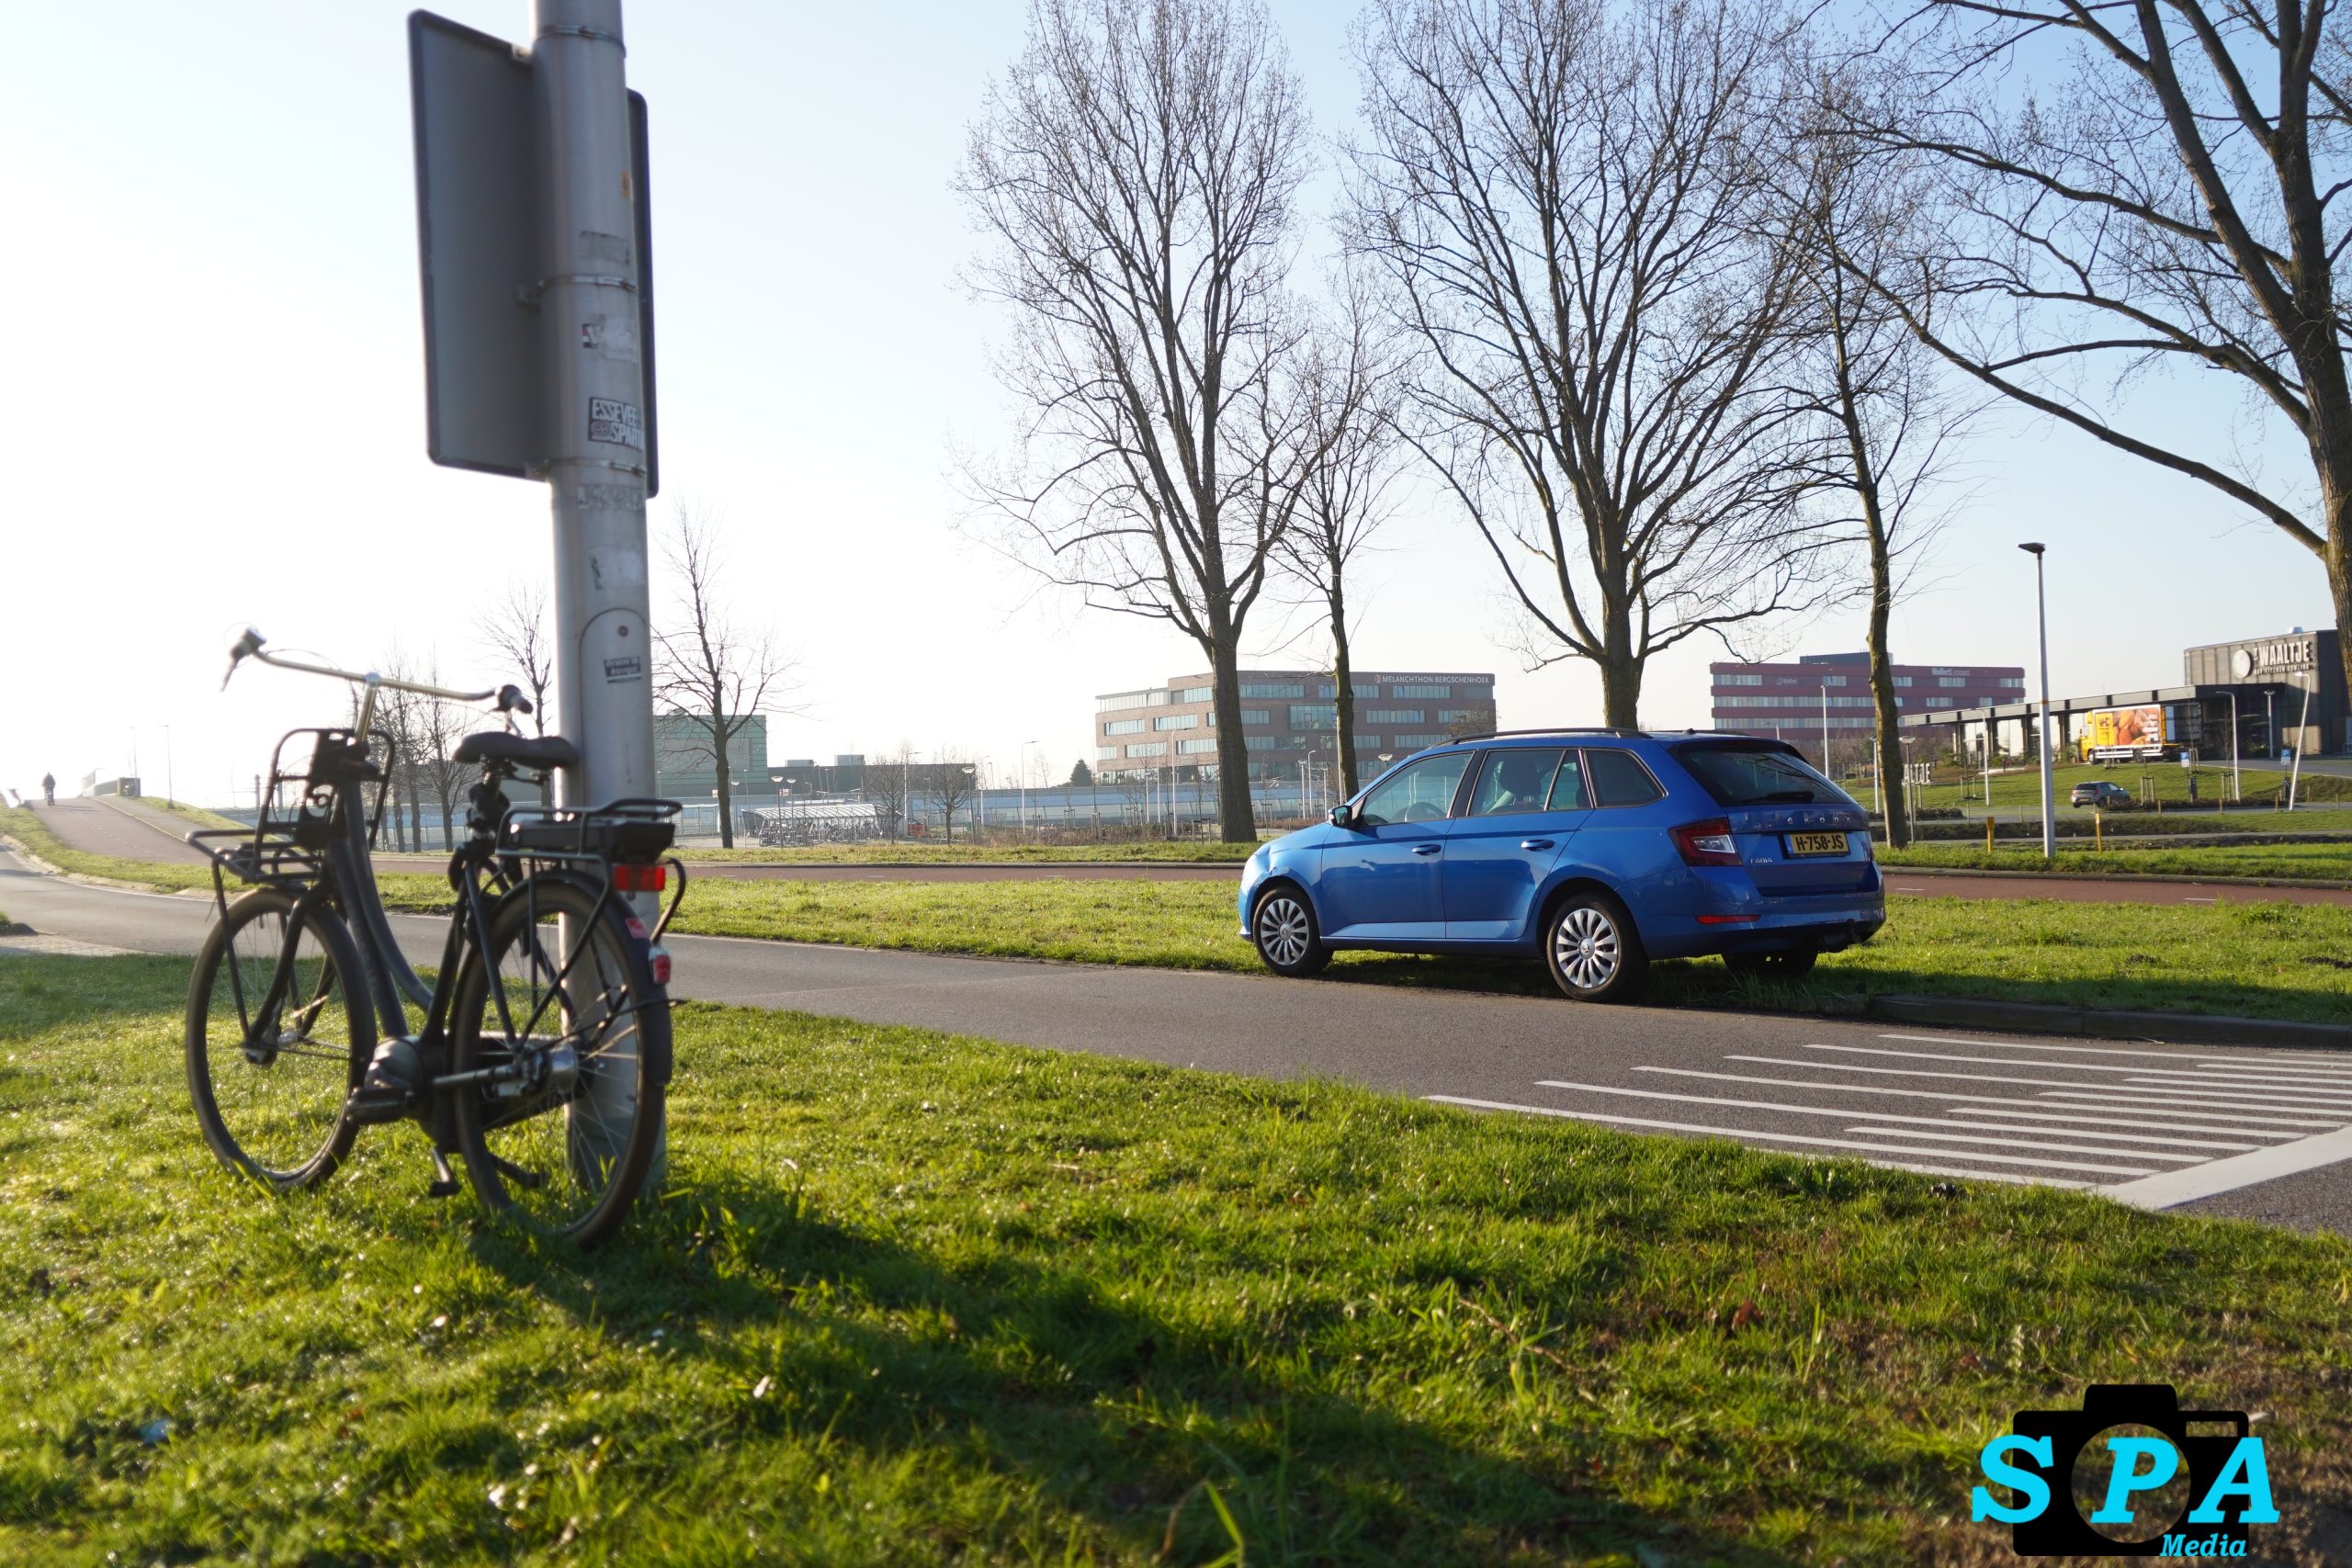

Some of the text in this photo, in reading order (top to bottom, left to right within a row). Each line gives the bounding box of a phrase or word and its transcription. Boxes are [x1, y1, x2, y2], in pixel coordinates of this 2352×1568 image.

[2259, 641, 2310, 666] WAALTJE
[1382, 675, 1489, 684] MELANCHTHON BERGSCHENHOEK
[1794, 834, 1845, 852] H-758-JS
